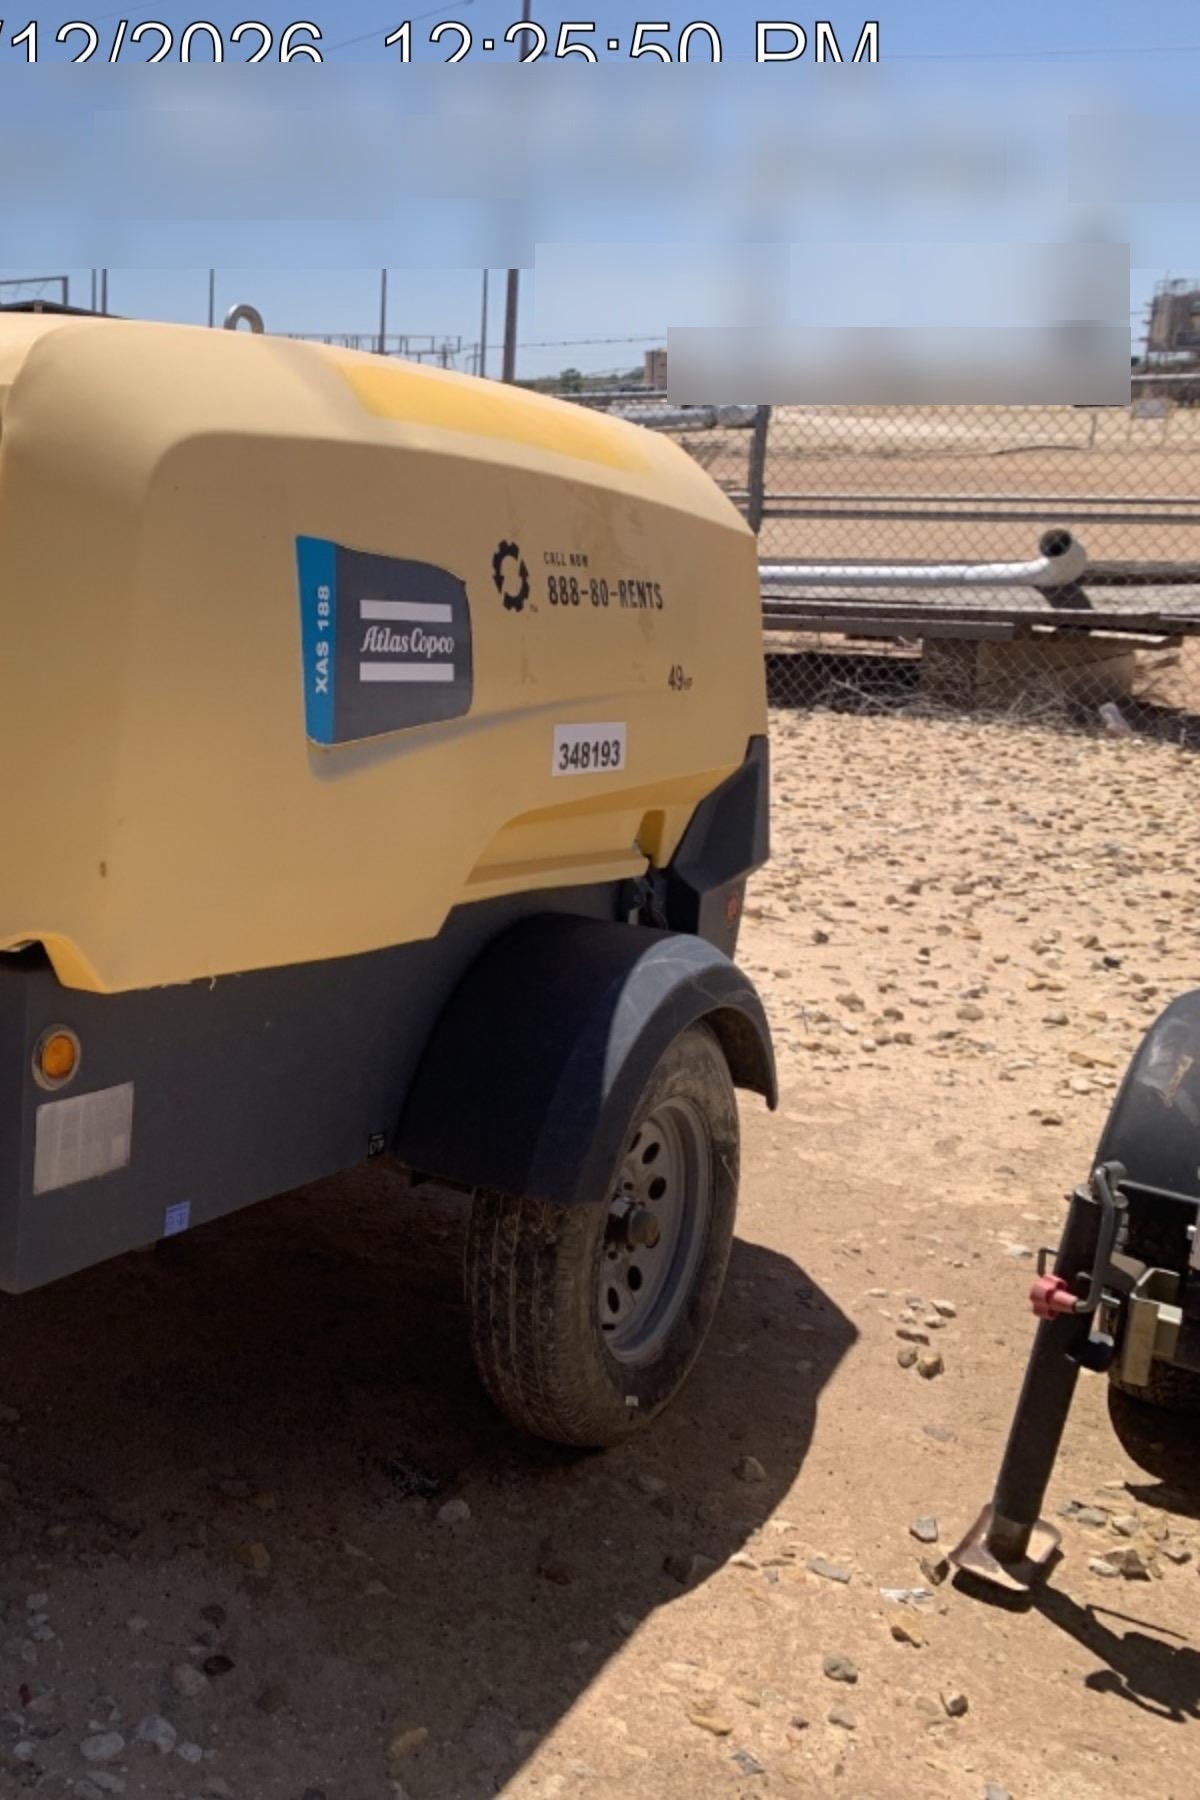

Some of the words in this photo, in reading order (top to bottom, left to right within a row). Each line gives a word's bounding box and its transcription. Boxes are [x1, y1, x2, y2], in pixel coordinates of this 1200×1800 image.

[316, 584, 331, 631] 188
[547, 575, 663, 610] 888-80-RENTS
[360, 625, 408, 653] Atlas
[410, 627, 455, 659] Copco
[315, 641, 329, 694] XAS
[558, 739, 621, 770] 348193
